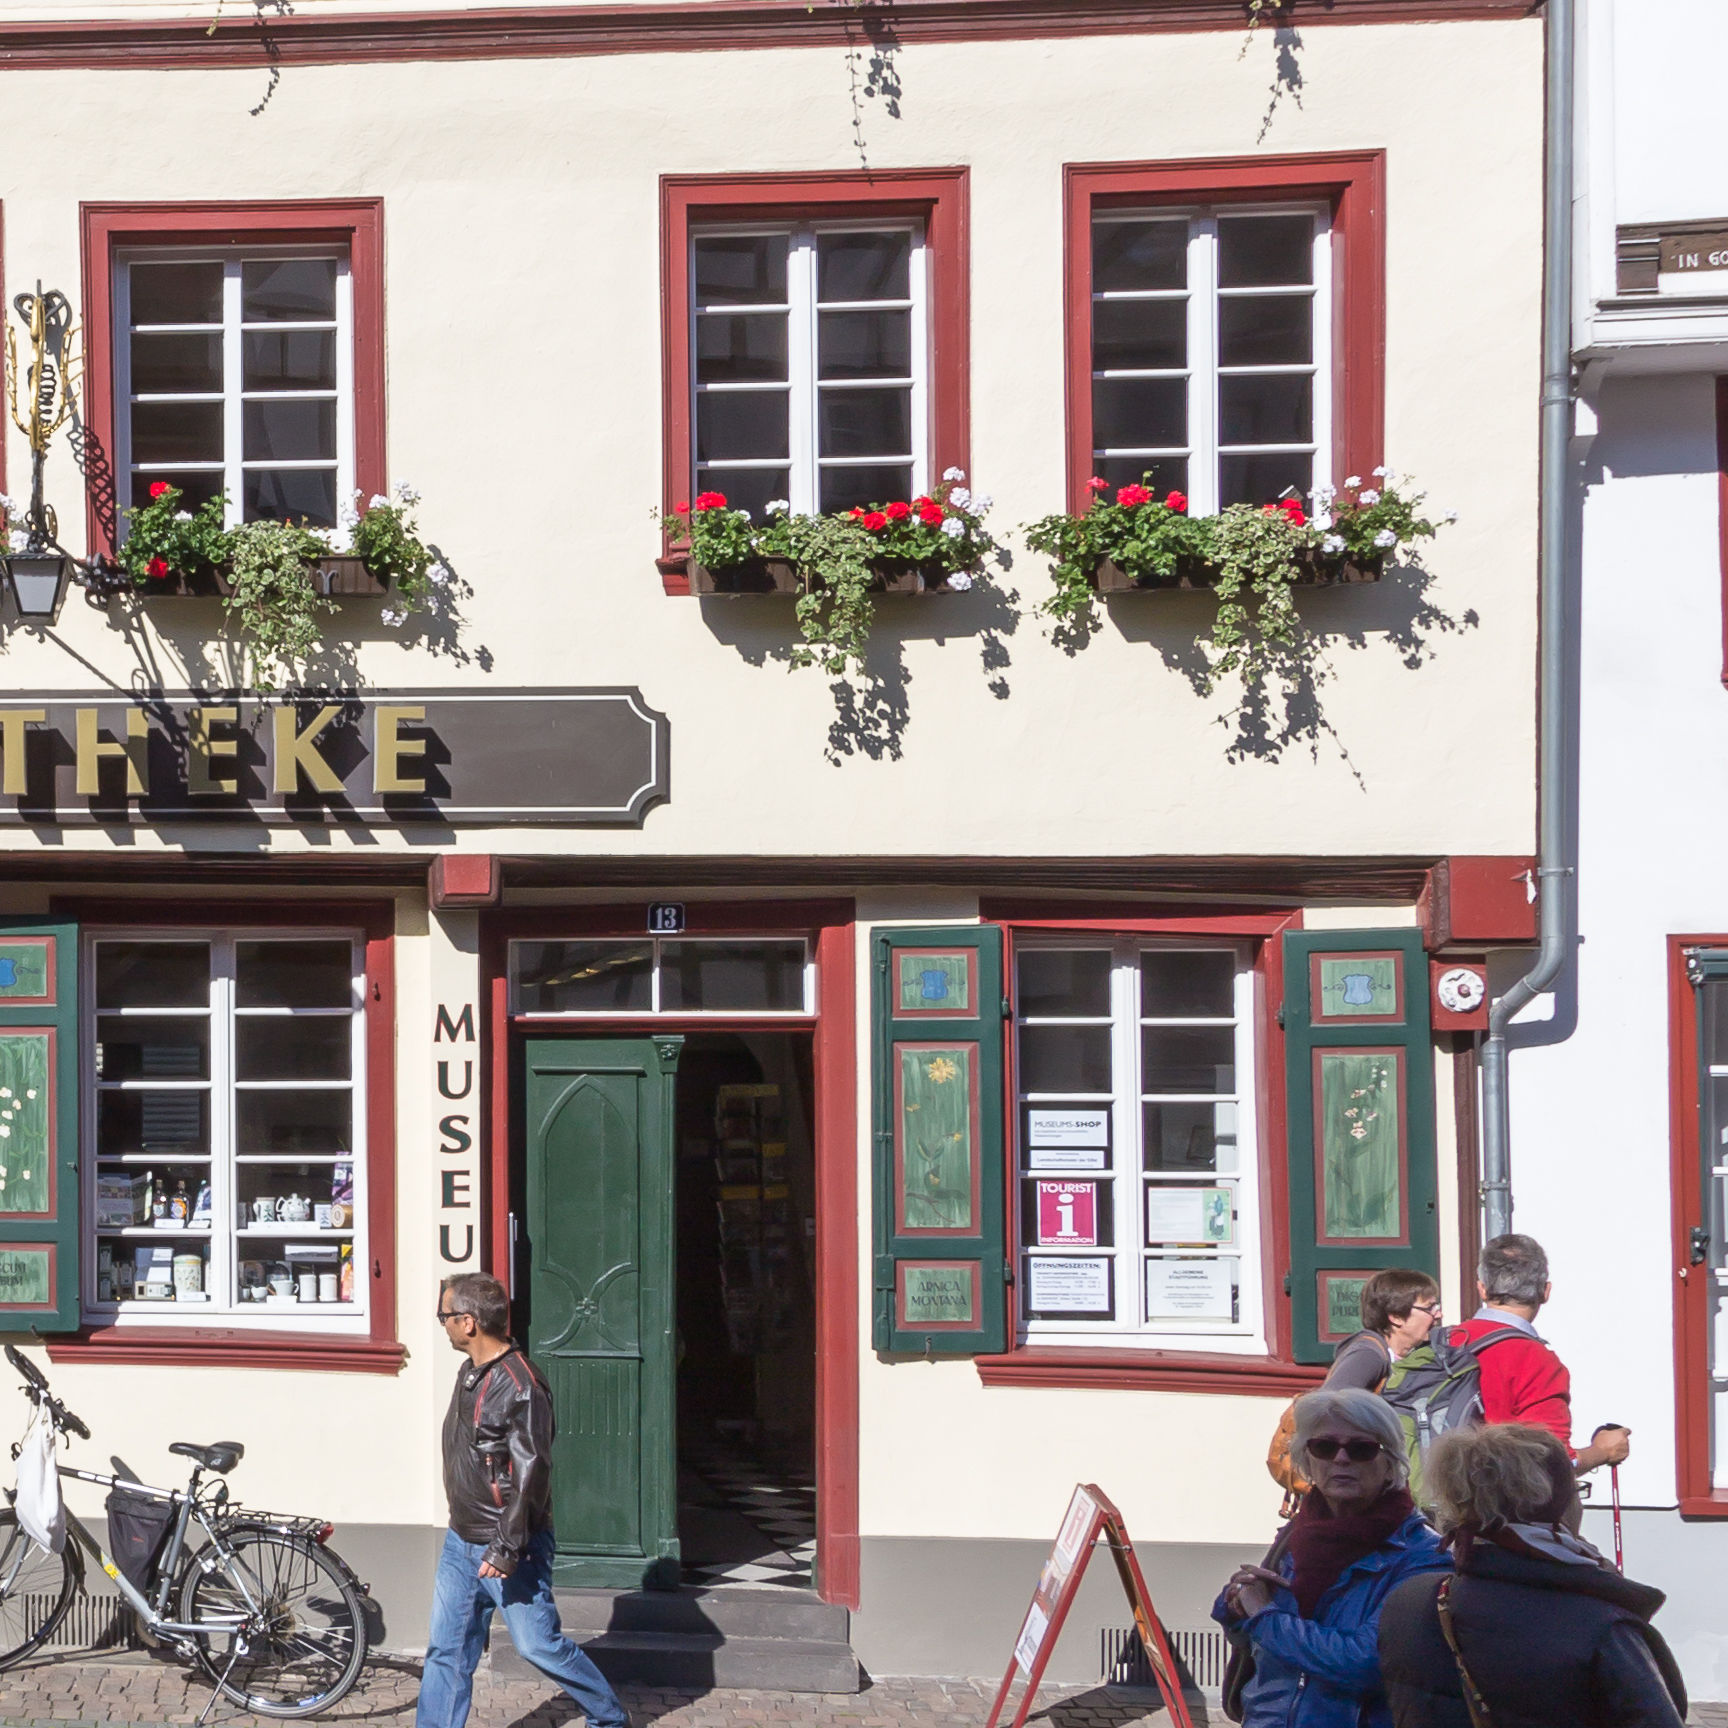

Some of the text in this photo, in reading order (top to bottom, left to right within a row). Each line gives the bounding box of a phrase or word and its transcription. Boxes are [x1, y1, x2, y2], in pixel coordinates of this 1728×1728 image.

[1677, 253, 1699, 269] IN
[655, 907, 677, 929] 13
[434, 1003, 476, 1317] MUSEU
[1040, 1183, 1092, 1194] TOURIST
[918, 1280, 961, 1292] ARNICA
[911, 1295, 968, 1306] MONTANA
